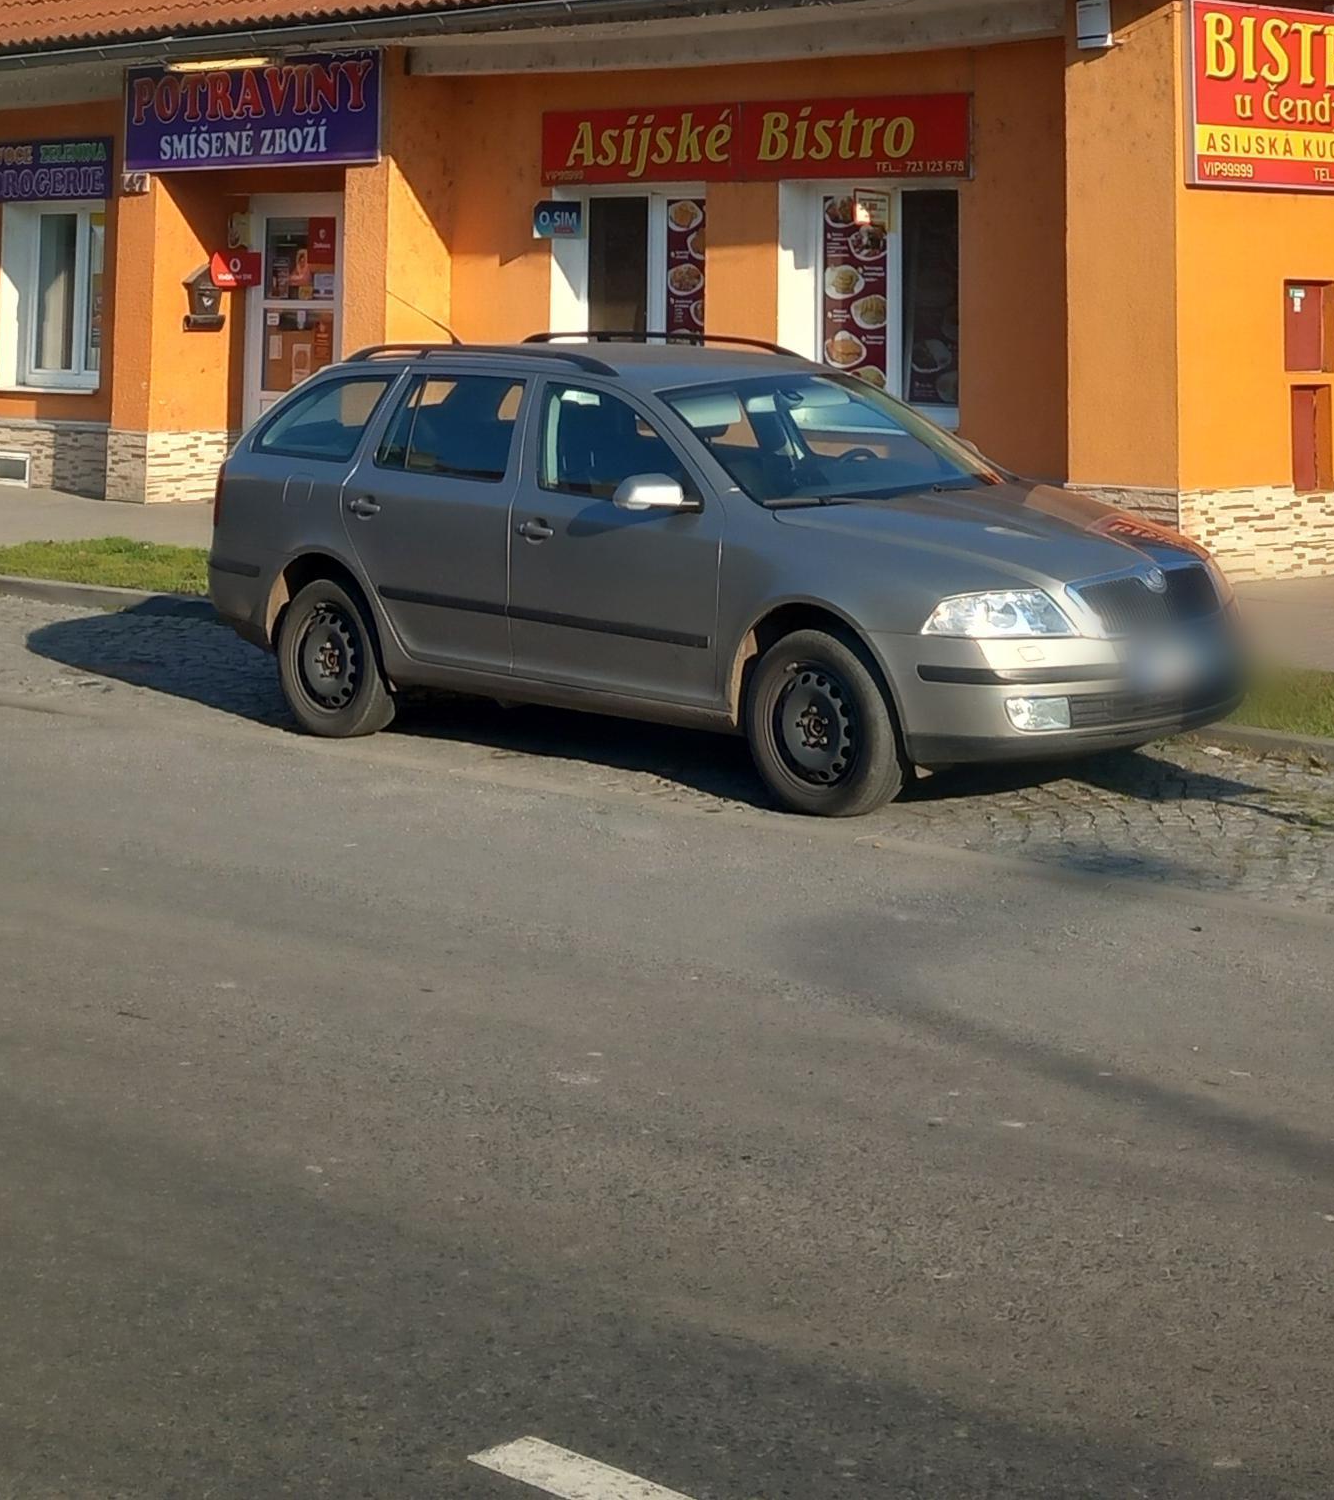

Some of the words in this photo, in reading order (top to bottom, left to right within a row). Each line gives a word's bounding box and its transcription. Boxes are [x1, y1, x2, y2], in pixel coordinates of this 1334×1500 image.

[132, 60, 373, 126] POTRAVINY
[1234, 94, 1253, 120] u
[160, 124, 253, 160] SMÍŠENÉ
[260, 118, 328, 154] ZBOŽÍ
[566, 109, 733, 178] Asijské
[757, 106, 916, 162] Bistro
[1206, 132, 1293, 157] ASIJSKÁ
[905, 161, 923, 172] 723
[926, 161, 943, 172] 123
[945, 161, 965, 171] 678
[1203, 161, 1254, 178] VIP99999
[554, 211, 577, 226] SIM
